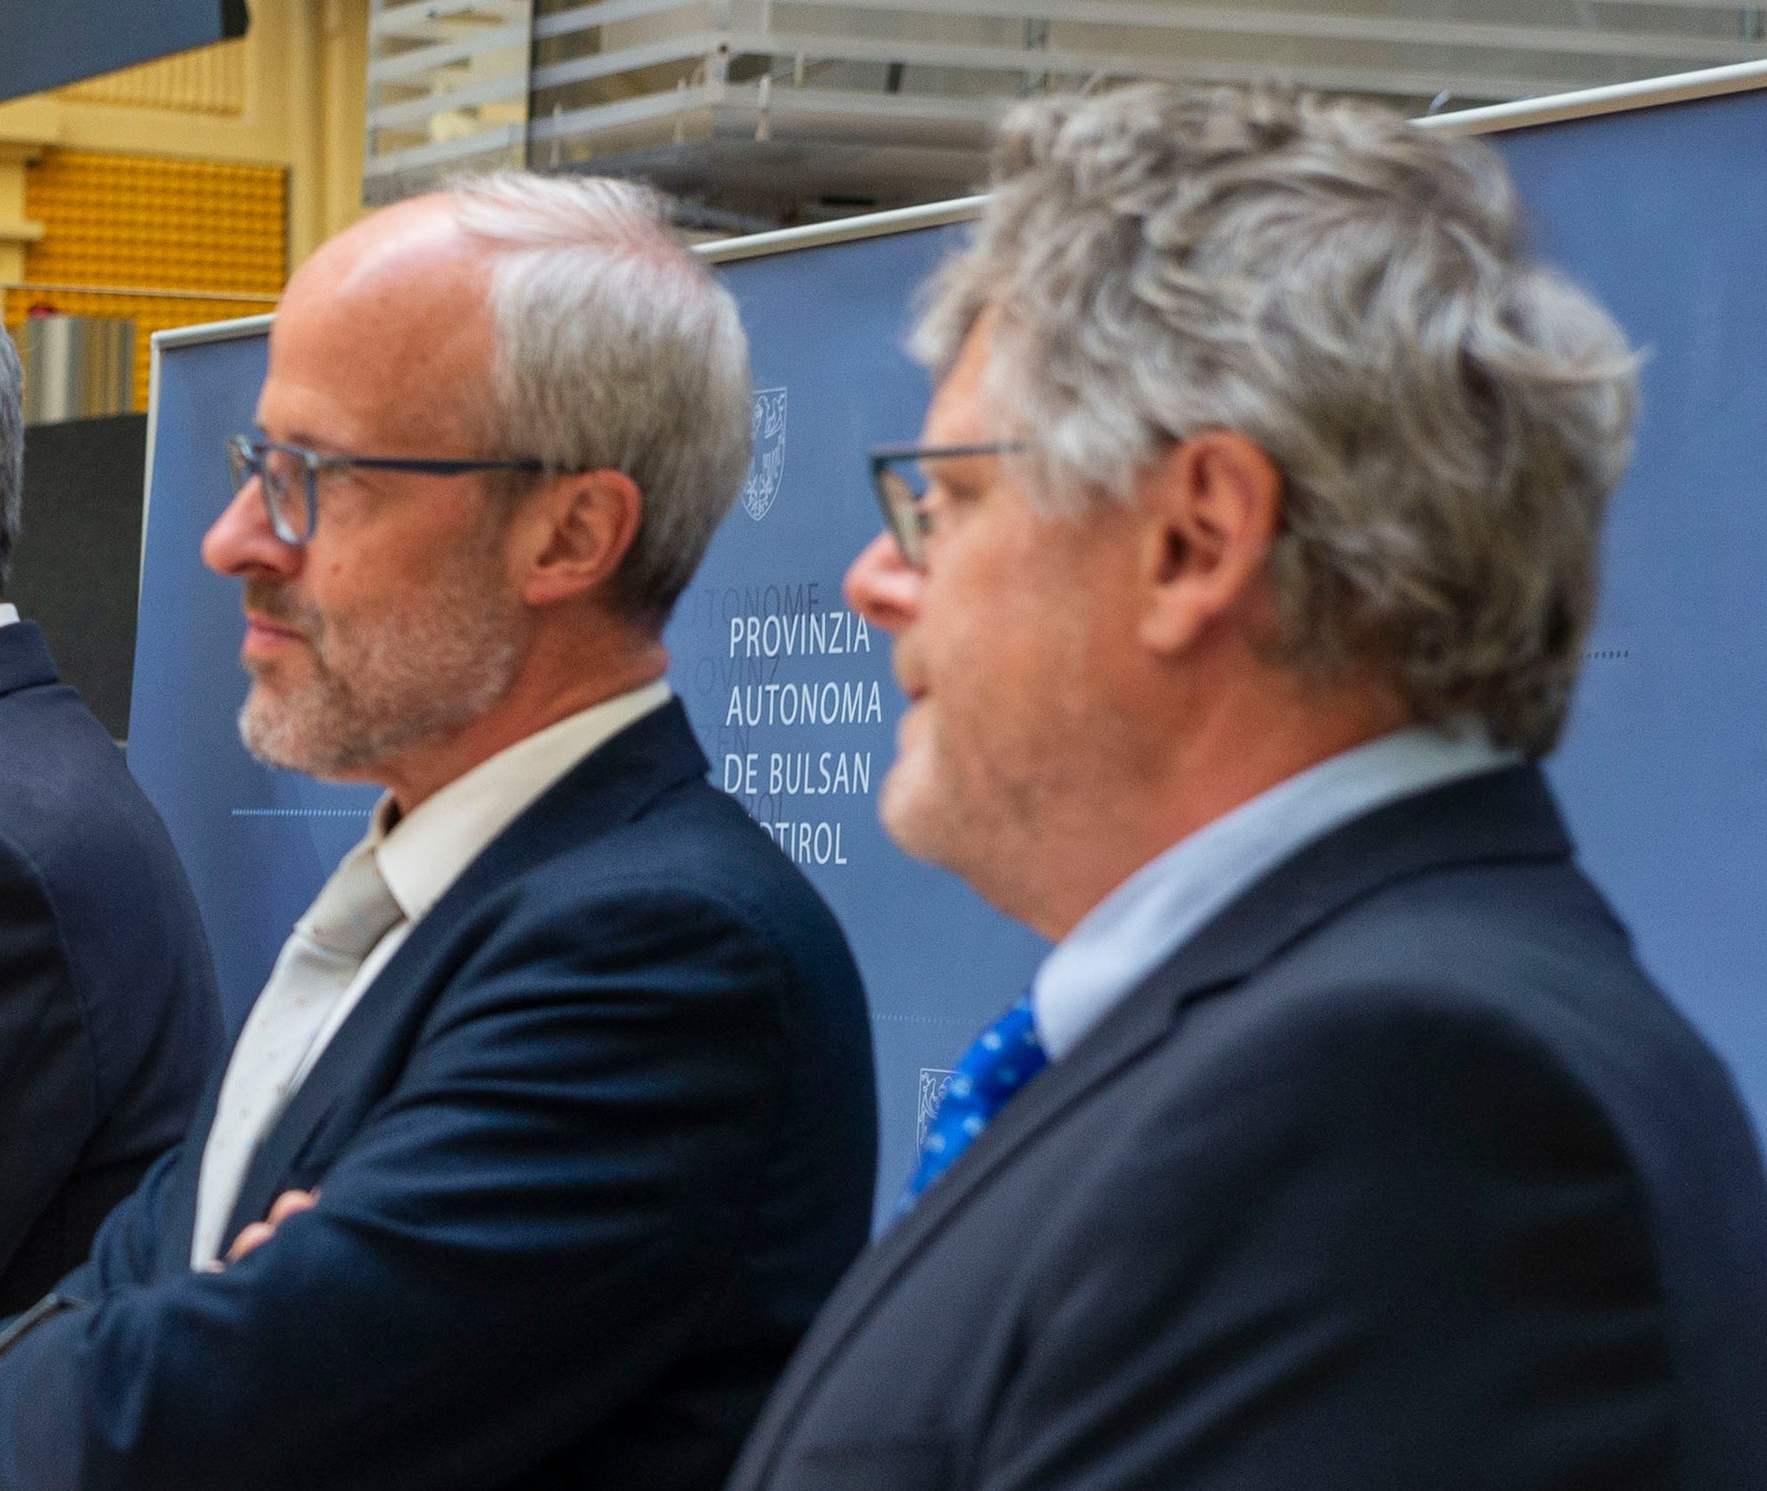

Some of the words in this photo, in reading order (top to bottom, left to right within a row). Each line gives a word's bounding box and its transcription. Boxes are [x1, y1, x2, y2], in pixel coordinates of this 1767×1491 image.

[729, 611, 871, 658] PROVINZIA
[725, 680, 882, 727] AUTONOMA
[723, 753, 758, 795] DE
[769, 752, 871, 795] BULSAN
